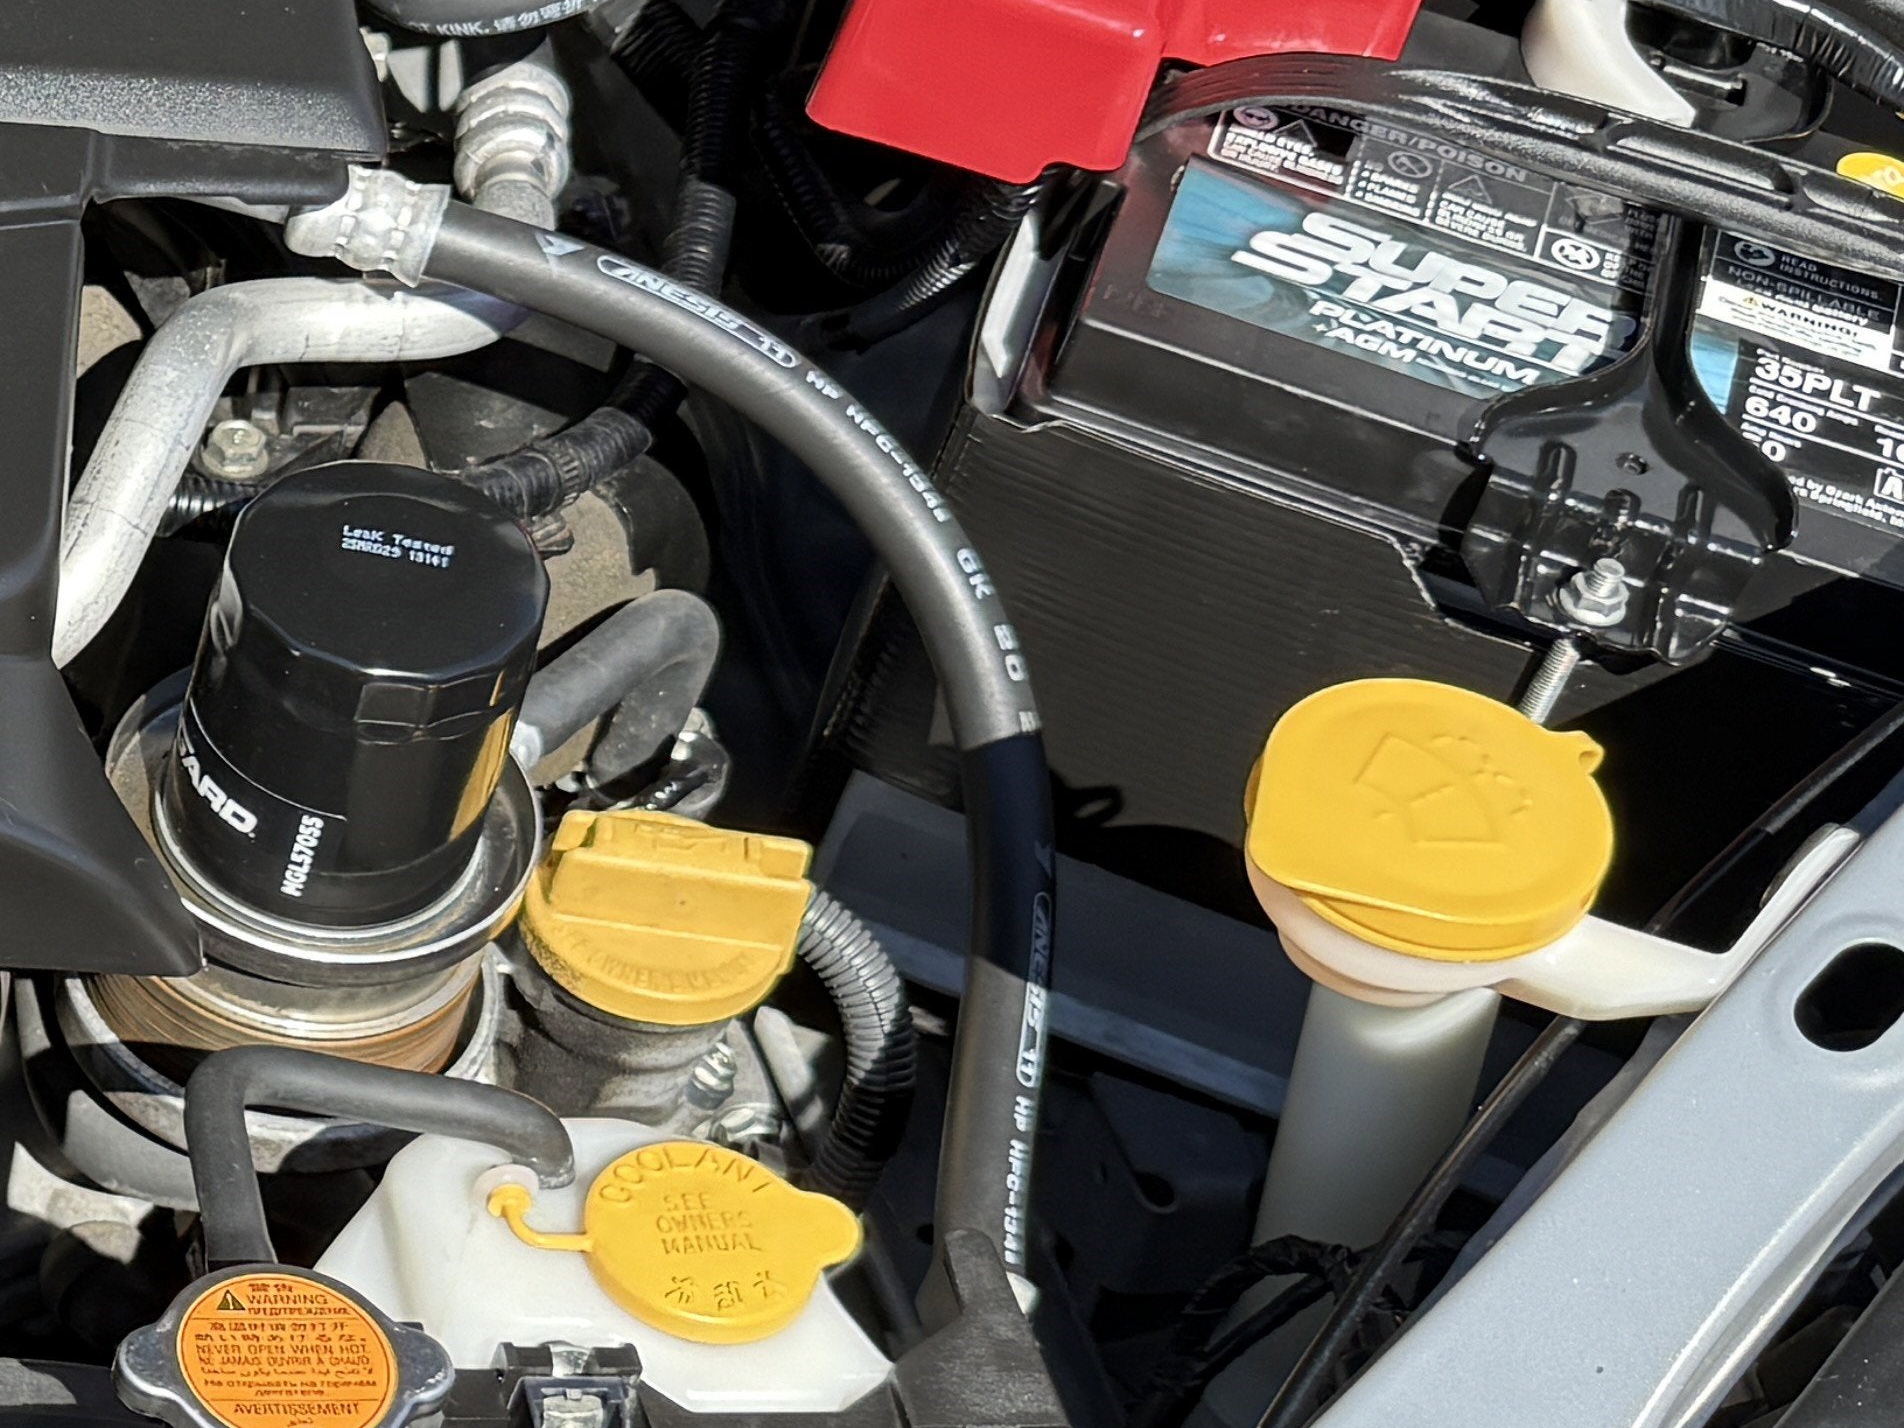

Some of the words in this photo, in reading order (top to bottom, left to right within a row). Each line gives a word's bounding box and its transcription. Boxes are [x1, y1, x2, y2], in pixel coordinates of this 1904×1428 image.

[1231, 230, 1605, 376] START
[1301, 212, 1637, 355] SUPER
[1310, 300, 1540, 386] PLATINUM
[1324, 326, 1419, 364] AGM
[1755, 356, 1883, 412] 35PLT
[1744, 395, 1817, 434] 640
[599, 1146, 772, 1204] COOLANT
[663, 1192, 713, 1212] SEE
[660, 1232, 763, 1256] MANUAL
[247, 1294, 329, 1305] WARNING
[234, 1403, 360, 1416] AVERTISSEMENT
